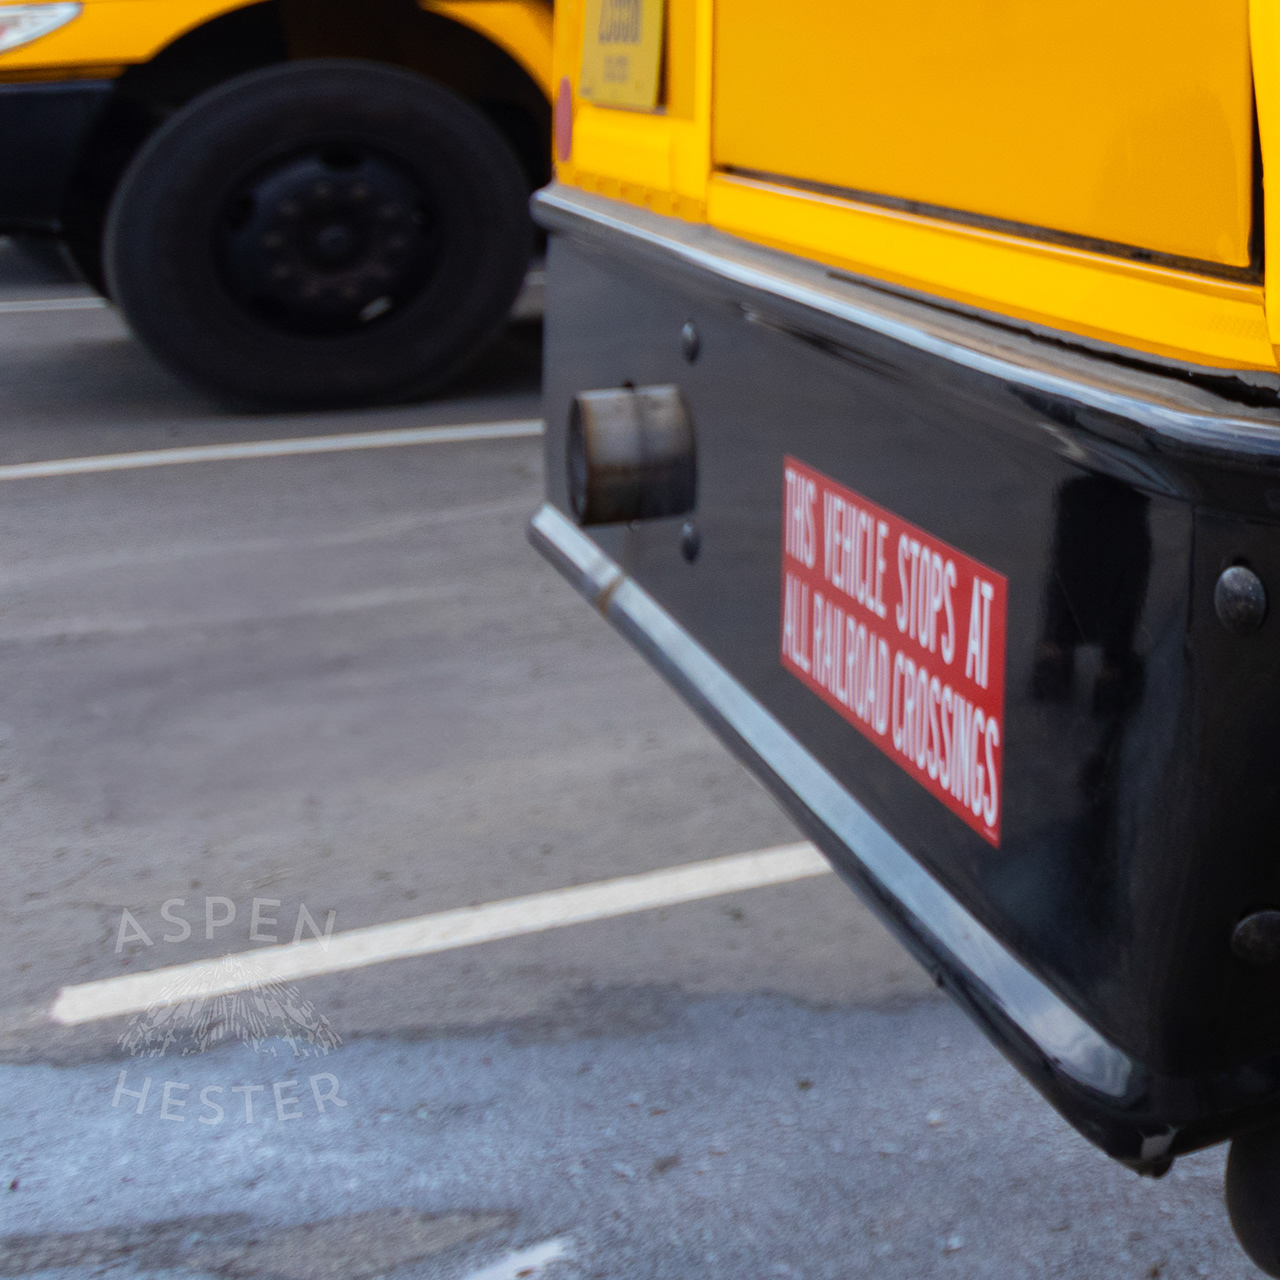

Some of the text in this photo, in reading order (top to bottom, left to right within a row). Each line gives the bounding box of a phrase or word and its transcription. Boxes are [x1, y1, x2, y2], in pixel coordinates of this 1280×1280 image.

[785, 468, 993, 690] THIS VEHICLE STOPS AT
[782, 571, 999, 828] ALL RAILROAD CROSSINGS
